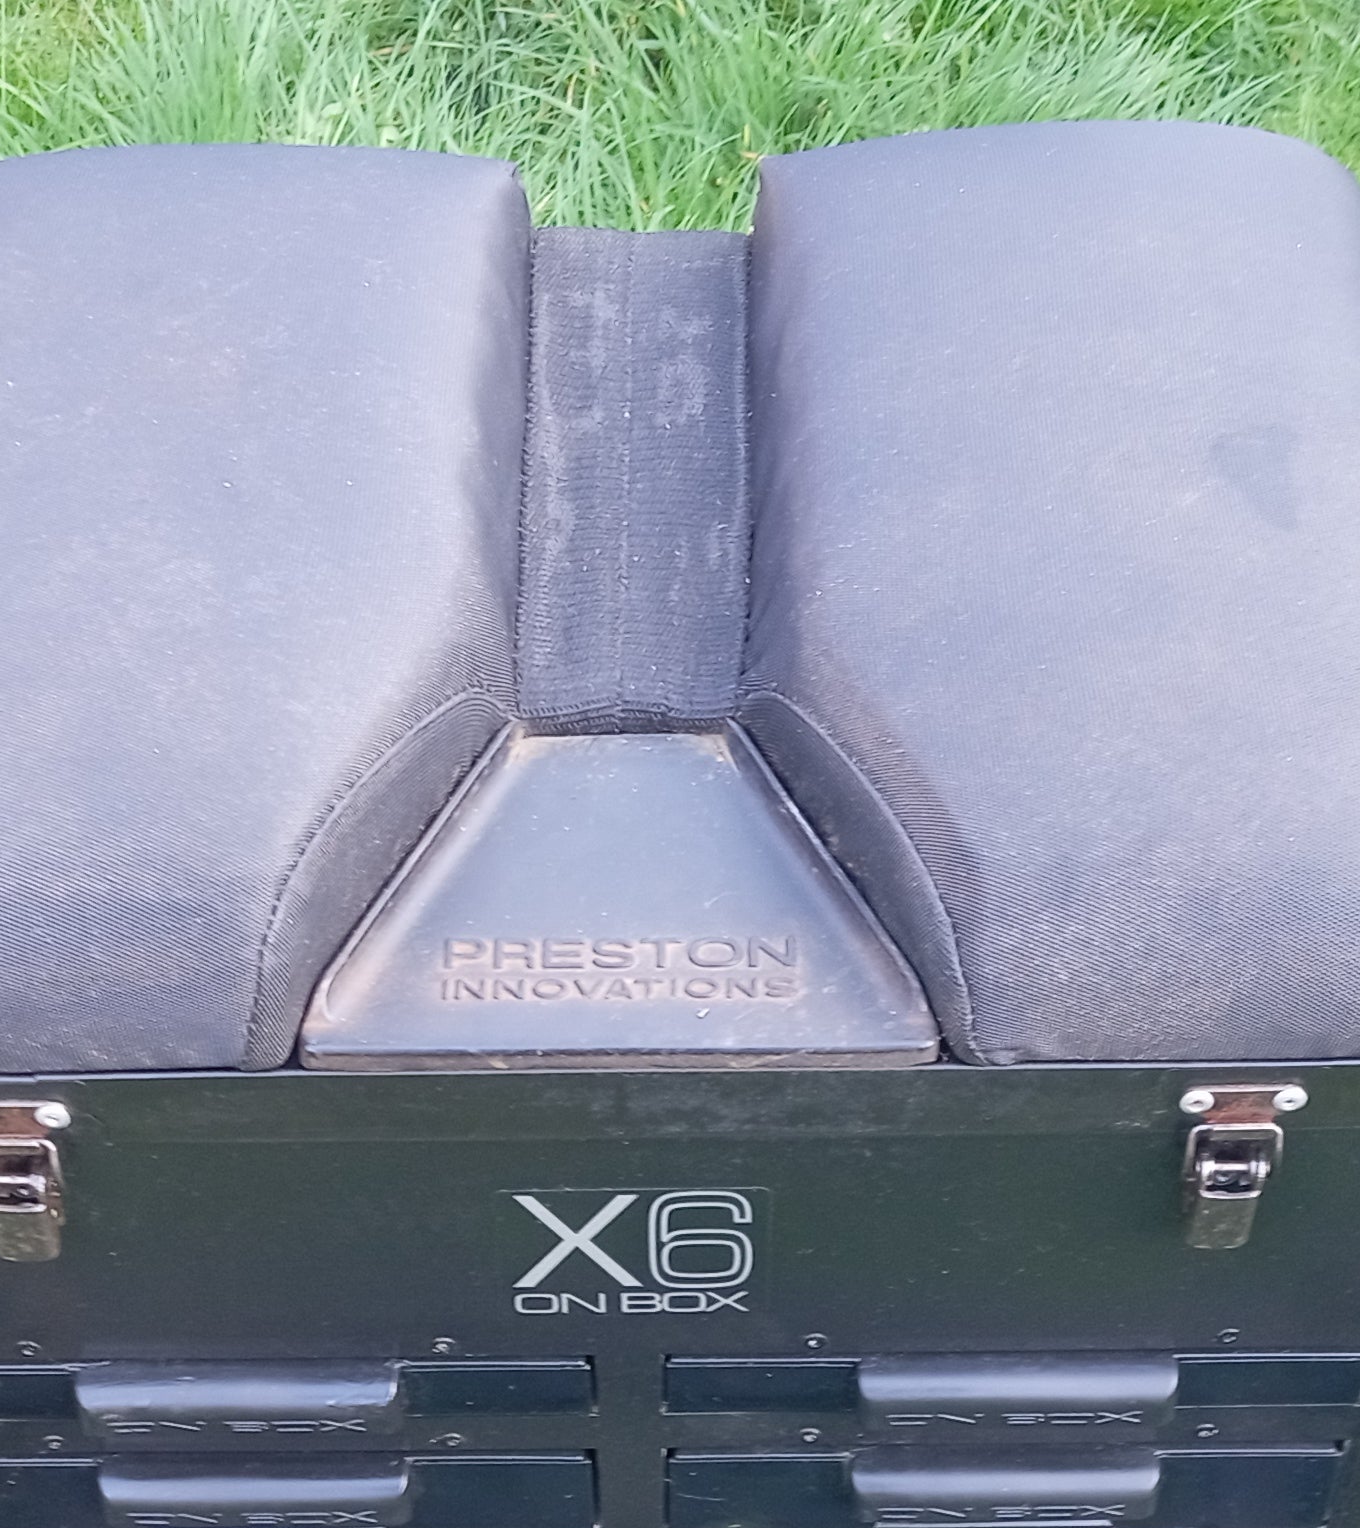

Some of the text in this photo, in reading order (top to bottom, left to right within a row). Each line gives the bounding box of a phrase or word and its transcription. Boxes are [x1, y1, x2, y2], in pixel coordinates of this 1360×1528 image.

[442, 936, 797, 970] PRESTON
[441, 976, 798, 1001] INNOVATIONS
[512, 1191, 753, 1290] X6
[513, 1291, 749, 1314] ON BOX
